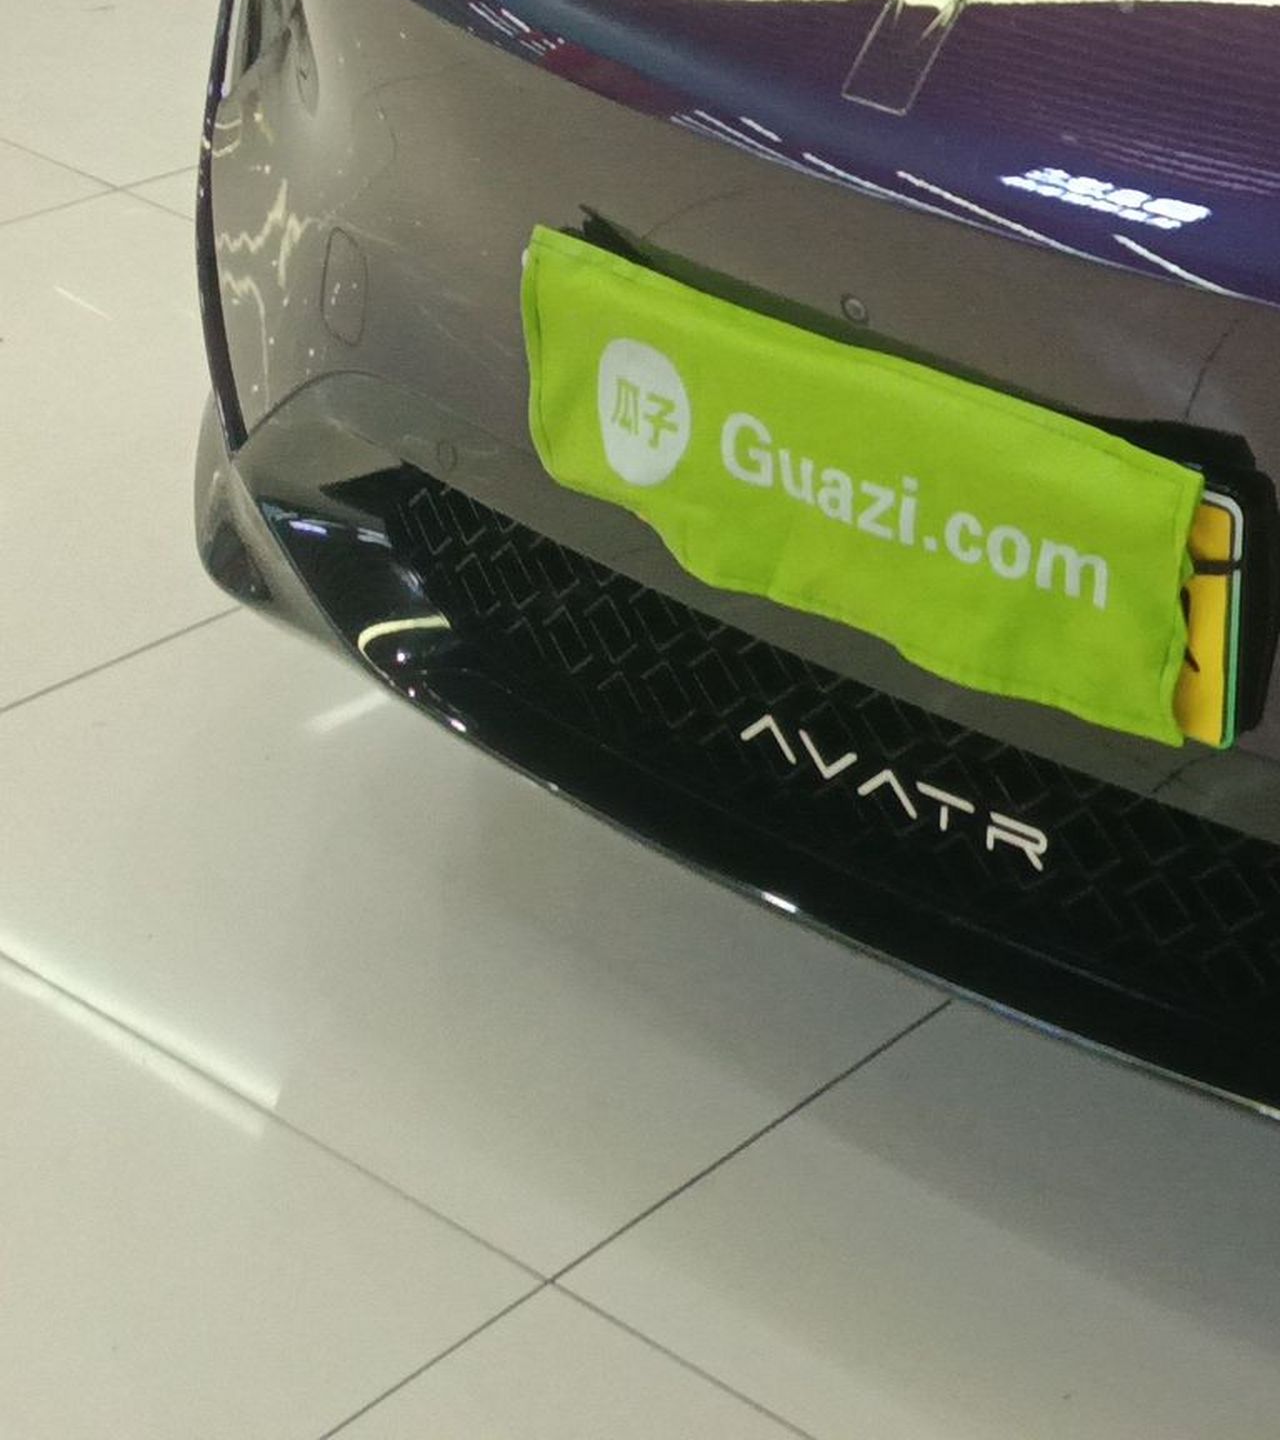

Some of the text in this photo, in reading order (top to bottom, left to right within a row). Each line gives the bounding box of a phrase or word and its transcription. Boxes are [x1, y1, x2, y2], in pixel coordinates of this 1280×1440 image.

[611, 377, 679, 451] 瓜子
[718, 411, 1111, 611] Guazi.com
[739, 713, 1048, 872] AVATR
